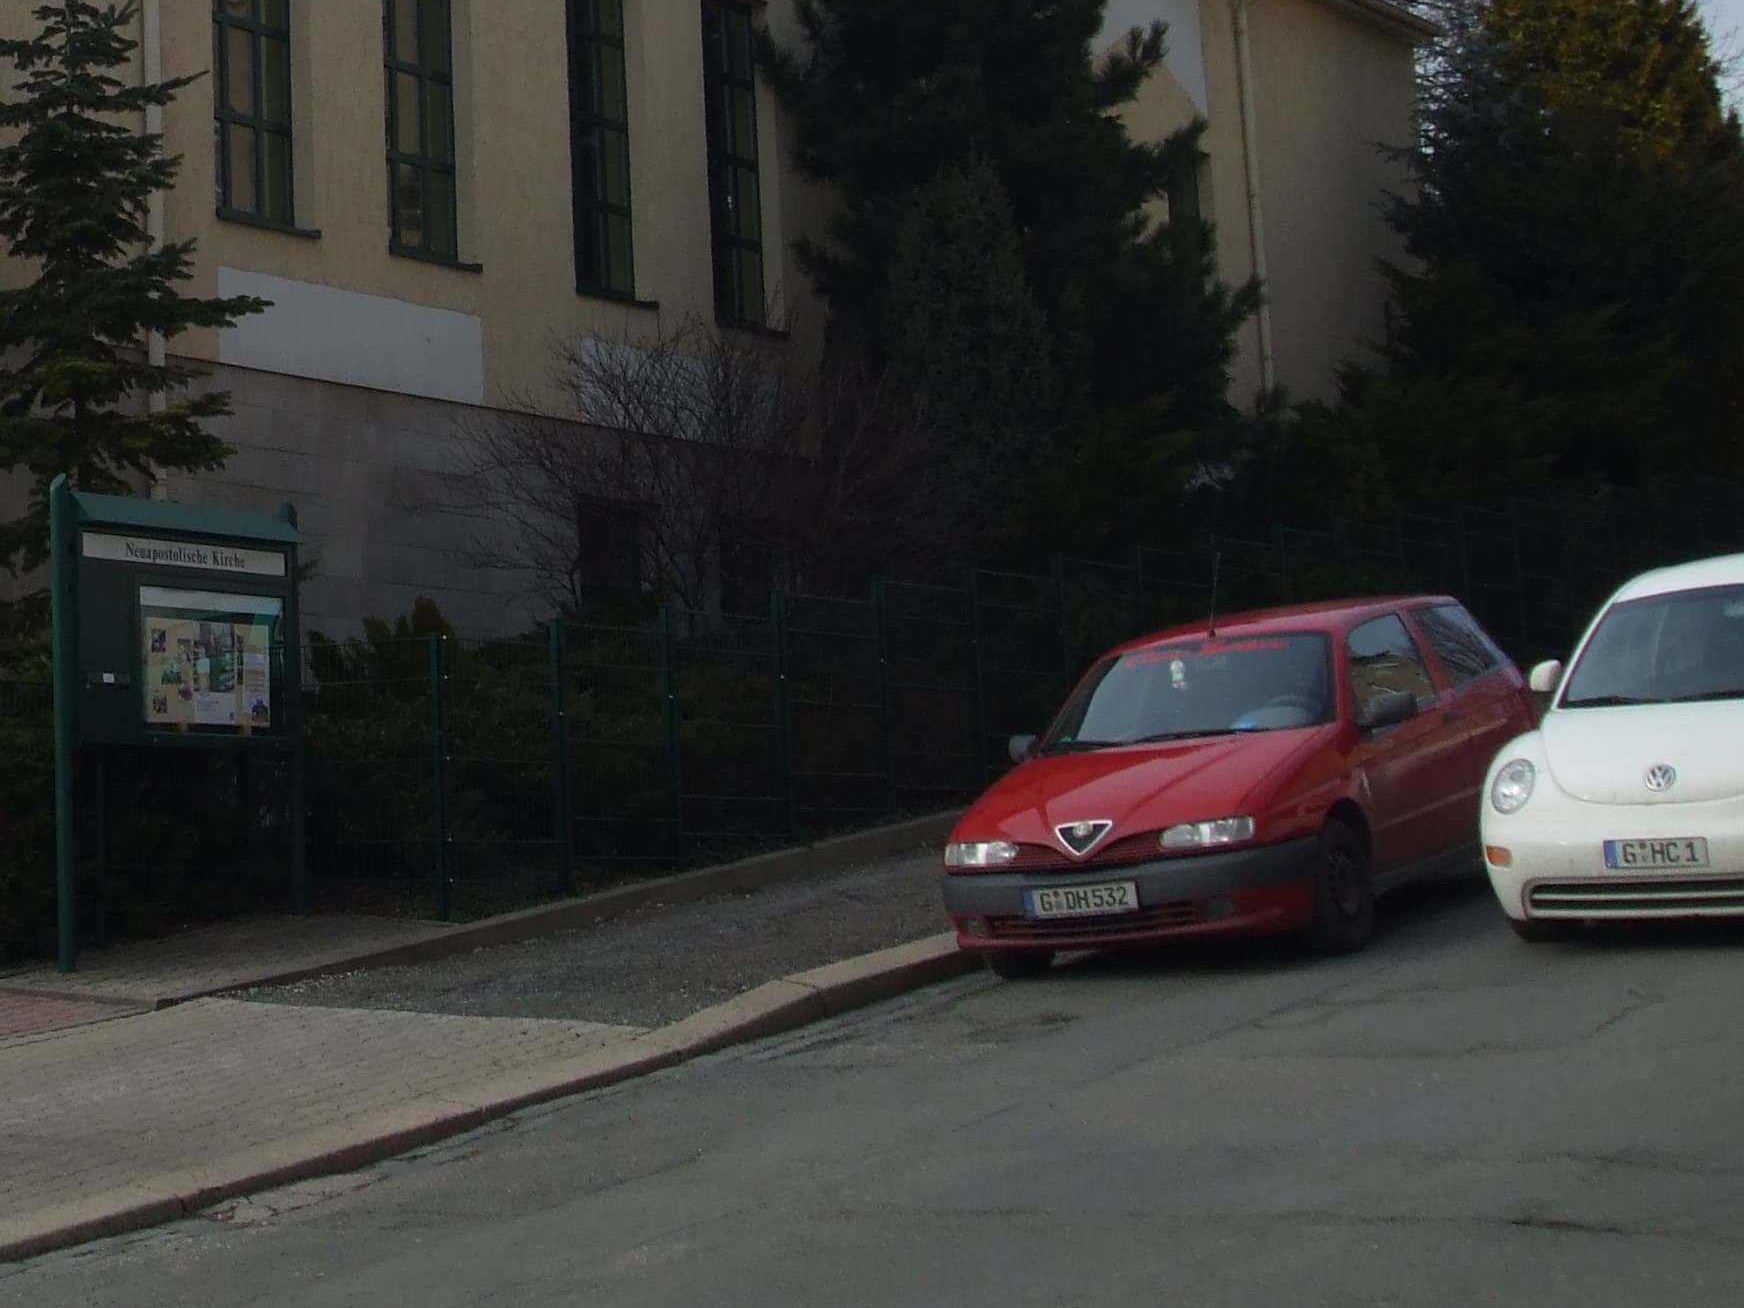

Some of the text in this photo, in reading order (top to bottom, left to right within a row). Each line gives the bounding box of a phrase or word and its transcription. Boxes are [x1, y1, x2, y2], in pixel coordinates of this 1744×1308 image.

[125, 542, 246, 568] Neuapostolische Kirche
[1622, 843, 1638, 864] G
[1039, 892, 1053, 912] G
